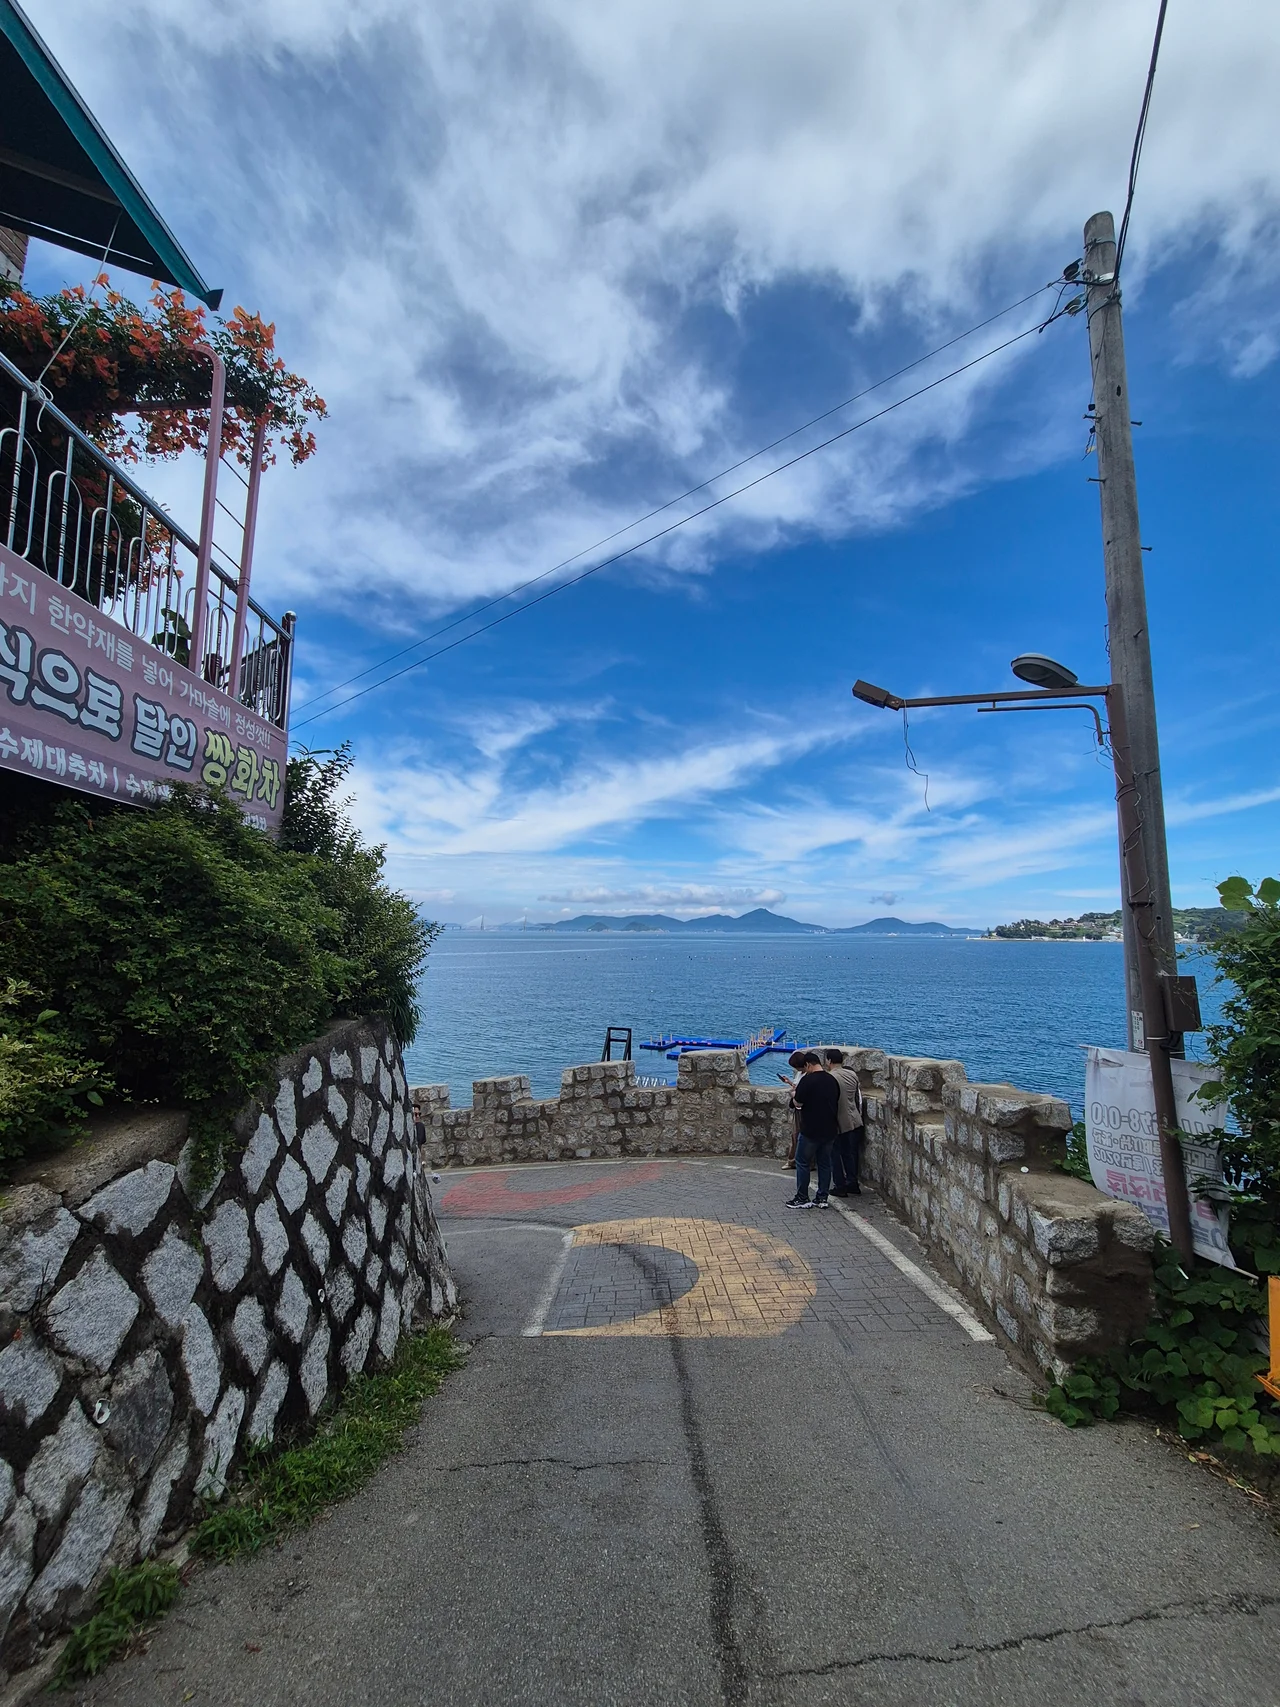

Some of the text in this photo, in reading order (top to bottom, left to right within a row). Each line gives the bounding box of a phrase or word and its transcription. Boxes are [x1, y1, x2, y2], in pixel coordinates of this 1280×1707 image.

[48, 595, 135, 672] 한약재를
[142, 655, 173, 695] 넣어
[180, 680, 231, 728] 가마솥에
[235, 713, 271, 750] 정성껏!!
[0, 727, 107, 788] 수제대추차
[132, 694, 197, 770] 달인
[203, 730, 281, 809] 쌍화차
